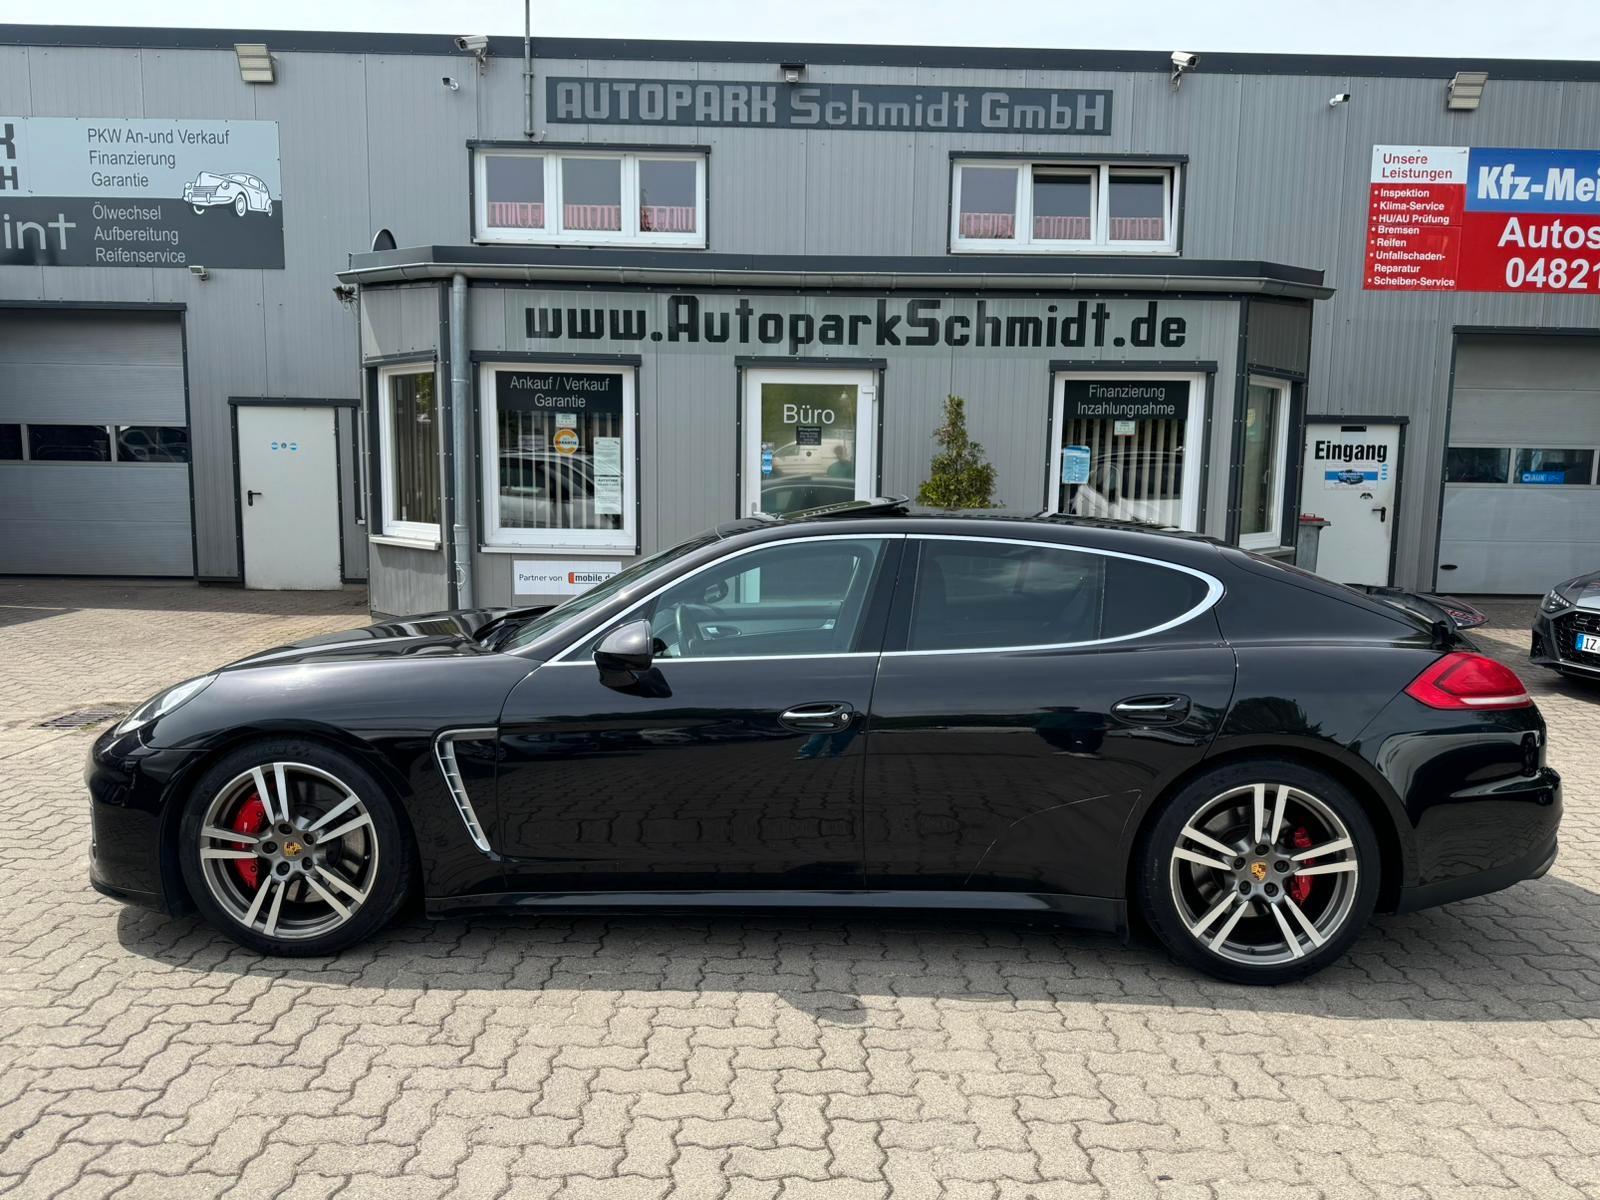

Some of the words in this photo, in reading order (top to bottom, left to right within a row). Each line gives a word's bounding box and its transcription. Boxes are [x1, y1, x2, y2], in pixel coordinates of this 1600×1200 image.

[556, 80, 775, 124] AUTOPARK
[790, 87, 969, 128] Schmidt
[981, 84, 1105, 131] GmbH
[87, 128, 122, 144] PKW
[125, 128, 173, 145] An-und
[177, 129, 230, 145] Verkauf
[89, 150, 176, 169] Finanzierung
[1383, 152, 1428, 165] Unsere
[91, 171, 149, 187] Garantie
[1381, 167, 1453, 181] Leistungen
[1380, 188, 1430, 199] Inspektion
[92, 201, 161, 220] Ölwechsel
[1379, 201, 1445, 211] Klima-Service
[1378, 214, 1410, 224] HU/AU
[1412, 214, 1450, 226] Prüfung
[94, 226, 179, 244] Aufbereitung
[1378, 225, 1420, 235] Bremsen
[1497, 217, 1600, 249] Autos
[1377, 238, 1407, 247] Reifen
[95, 247, 186, 264] Reifenservice
[1376, 251, 1446, 261] Unfallschaden-
[1374, 264, 1421, 275] Reparatur
[1373, 276, 1455, 287] Scheiben-Service
[525, 295, 1187, 355] www.AutoparkSchmidt.de
[510, 376, 553, 390] Ankauf
[563, 377, 610, 391] Verkauf
[1089, 384, 1166, 400] Finanzierung
[534, 393, 586, 408] Garantie
[783, 403, 835, 425] Büro
[1077, 401, 1175, 418] Inzahlungnahme
[1315, 440, 1387, 463] Eingang
[519, 573, 547, 582] Partner
[575, 573, 610, 582] mobile.d
[1584, 638, 1597, 650] IZ
